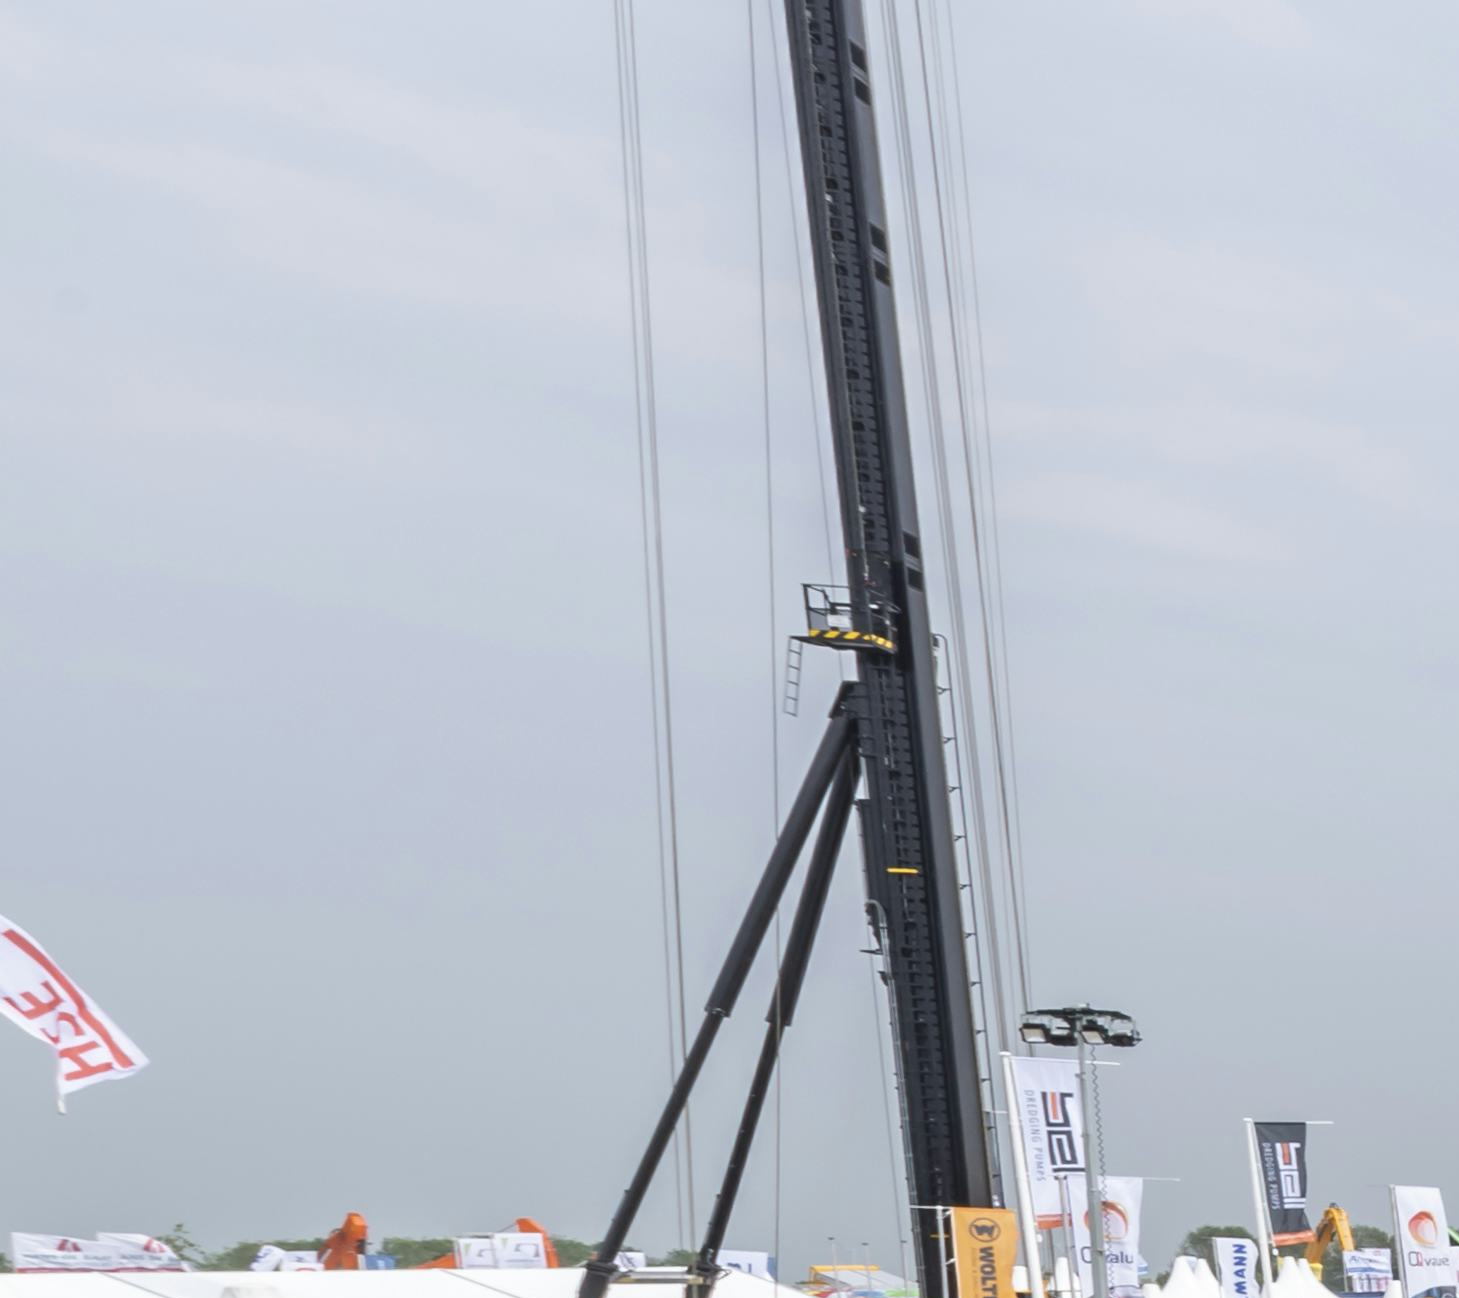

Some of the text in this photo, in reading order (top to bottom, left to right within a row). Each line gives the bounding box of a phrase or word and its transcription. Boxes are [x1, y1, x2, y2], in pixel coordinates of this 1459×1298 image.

[3, 980, 114, 1082] HSE
[1023, 1089, 1045, 1183] DREDGING PUMPS
[1261, 1142, 1279, 1211] DREDGING PUMPS
